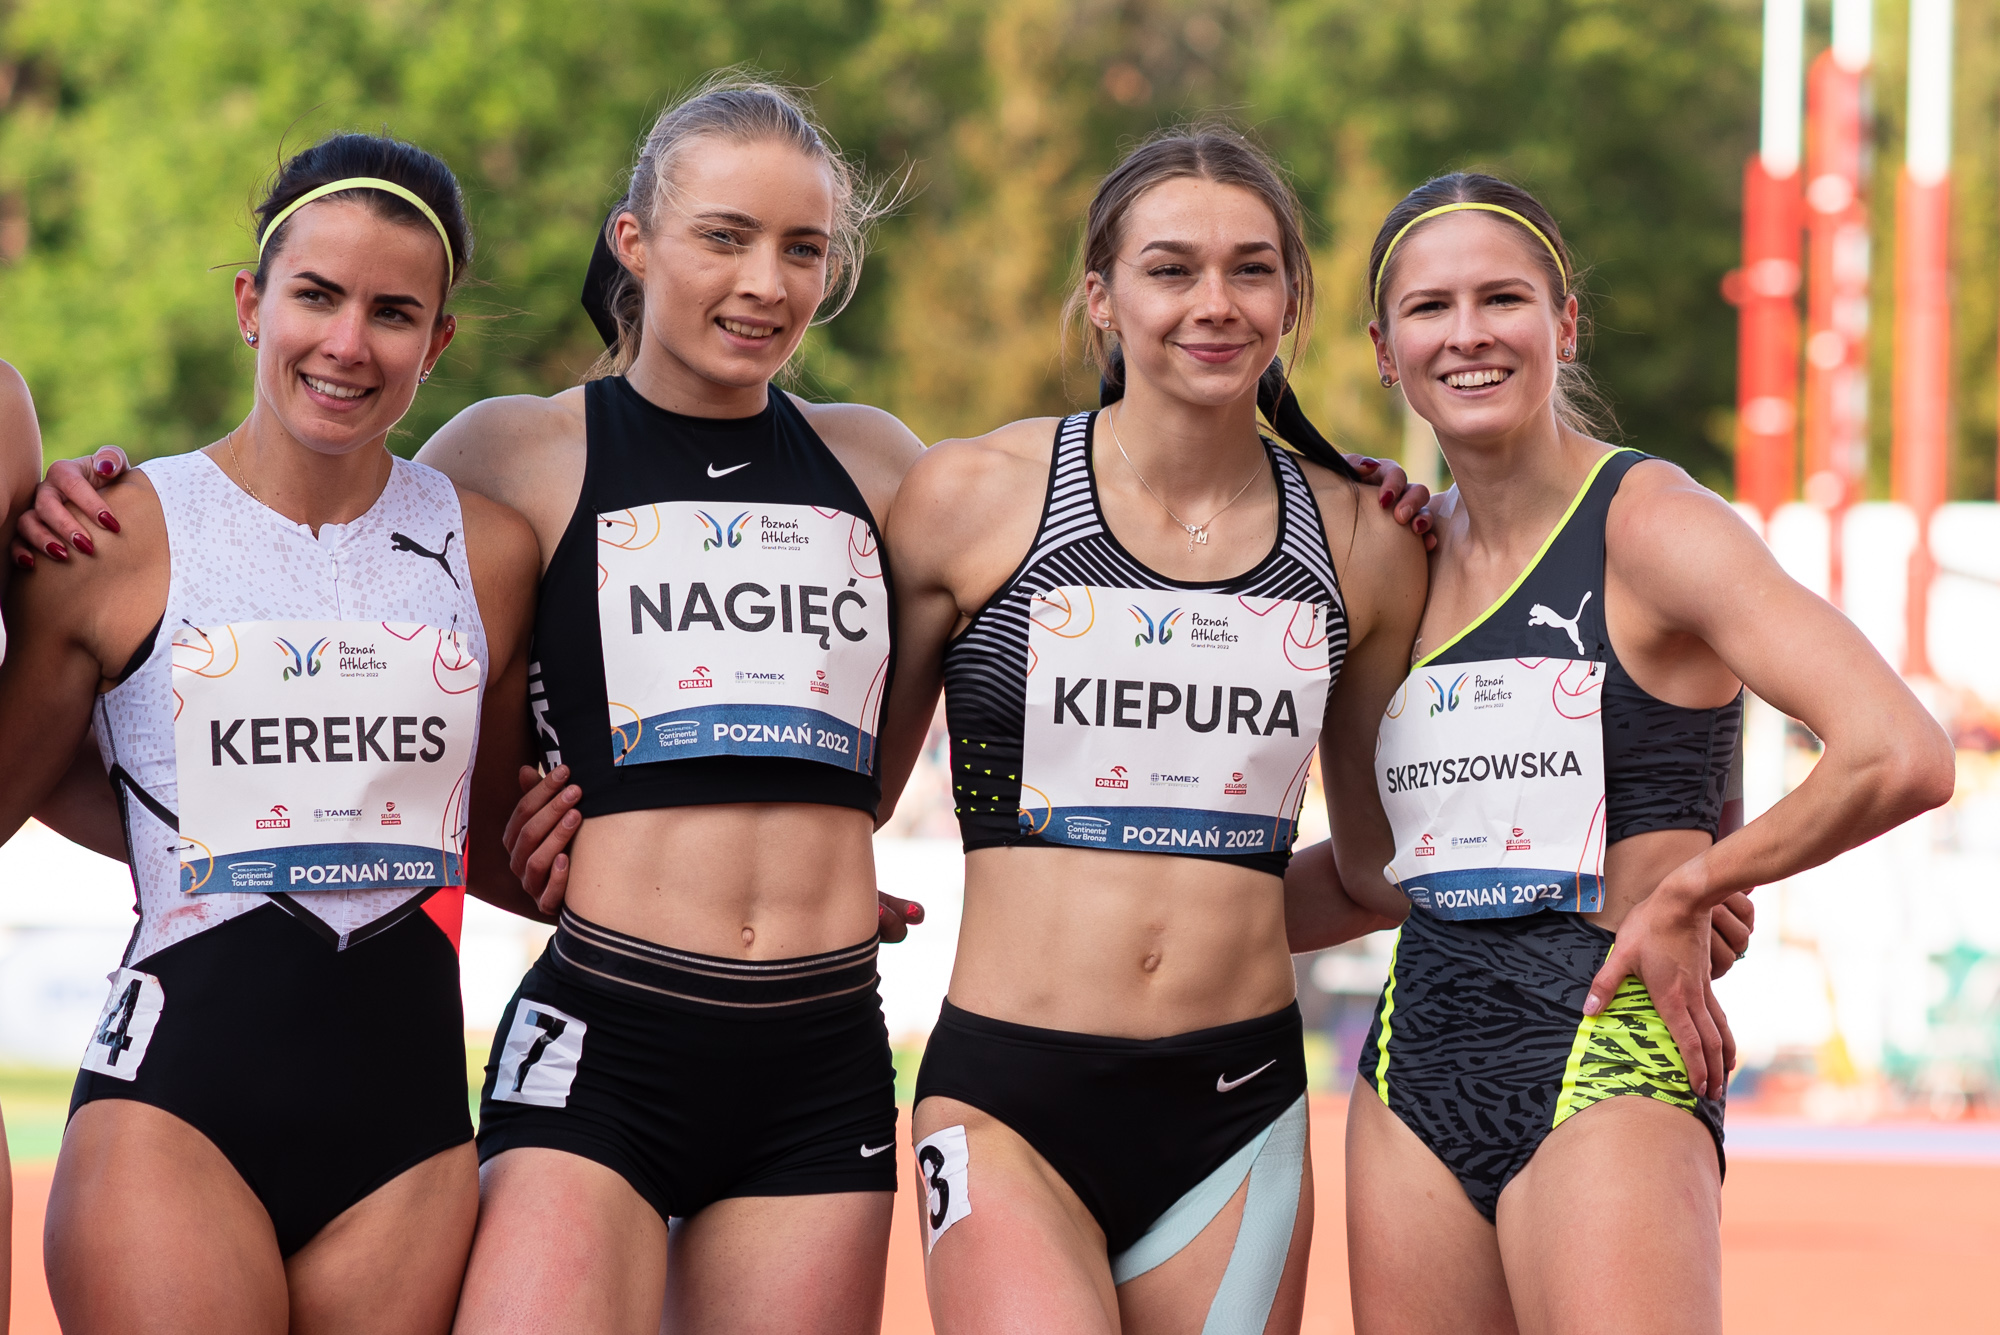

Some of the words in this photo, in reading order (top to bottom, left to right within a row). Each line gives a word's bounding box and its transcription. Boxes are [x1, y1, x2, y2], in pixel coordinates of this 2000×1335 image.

[761, 515, 798, 529] Poznań
[761, 531, 809, 544] Athletics
[630, 578, 868, 650] NAGIĘĆ
[1192, 612, 1228, 627] Poznań
[1191, 628, 1239, 642] Athletics
[339, 641, 375, 654] Poznań
[340, 657, 387, 670] Athletics
[745, 672, 785, 681] TAMEX
[1475, 674, 1504, 688] Poznań
[680, 679, 711, 688] ORLEN
[1474, 688, 1512, 703] Athletics
[1053, 677, 1299, 737] KIEPURA
[210, 716, 447, 766] KEREKES
[659, 730, 697, 740] Continental
[713, 722, 811, 745] POZNAŃ
[817, 729, 850, 754] 2022
[674, 738, 698, 746] Bronze
[1160, 774, 1200, 783] TAMEX
[1386, 750, 1583, 794] SKRZYSZOWSKA
[1096, 778, 1127, 788] ORLEN
[324, 809, 362, 817] TAMEX
[257, 820, 288, 828] ORLEN
[1067, 825, 1107, 835] Continental
[1067, 832, 1082, 840] Tour
[1082, 833, 1107, 842] Bronze
[1122, 826, 1220, 848] POZNAŃ
[1225, 828, 1265, 848] 2022
[1459, 836, 1488, 844] TAMEX
[1416, 847, 1434, 856] ORLEN
[231, 871, 273, 879] Continental
[290, 858, 387, 885] POZNAŃ
[393, 861, 436, 881] 2022
[232, 879, 248, 887] Tour
[1435, 883, 1506, 909] POZNAŃ
[1511, 884, 1563, 904] 2022
[97, 978, 142, 1067] 4
[511, 1009, 568, 1093] 7
[919, 1145, 949, 1230] 3
